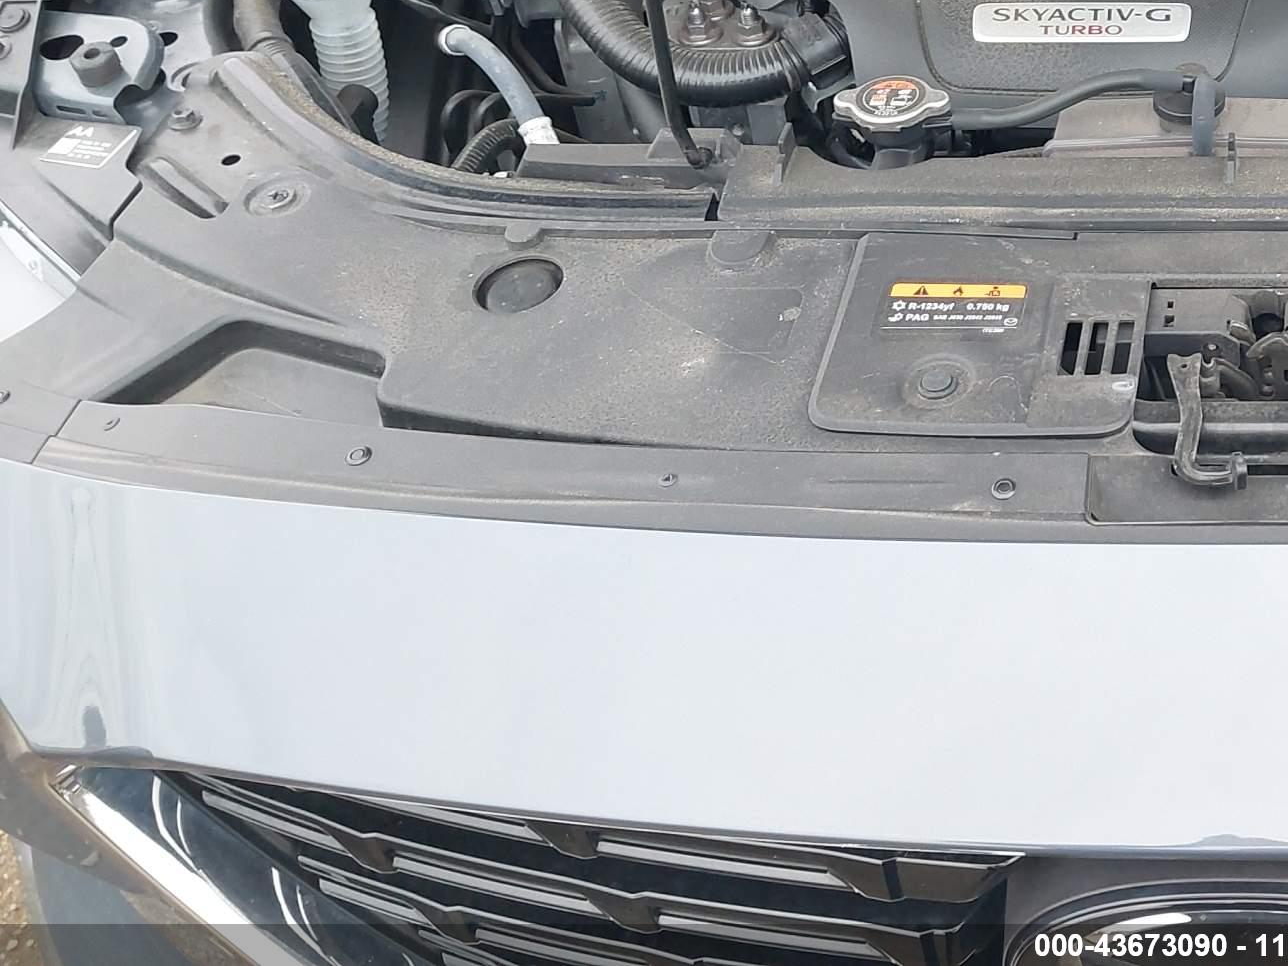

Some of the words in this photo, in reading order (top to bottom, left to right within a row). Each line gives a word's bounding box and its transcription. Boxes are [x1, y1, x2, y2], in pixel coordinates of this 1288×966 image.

[992, 8, 1172, 22] SKYACTIV-G
[1040, 25, 1123, 36] TURBO
[907, 302, 955, 312] R-1234yf
[995, 303, 1010, 312] kg
[905, 313, 930, 322] PAG
